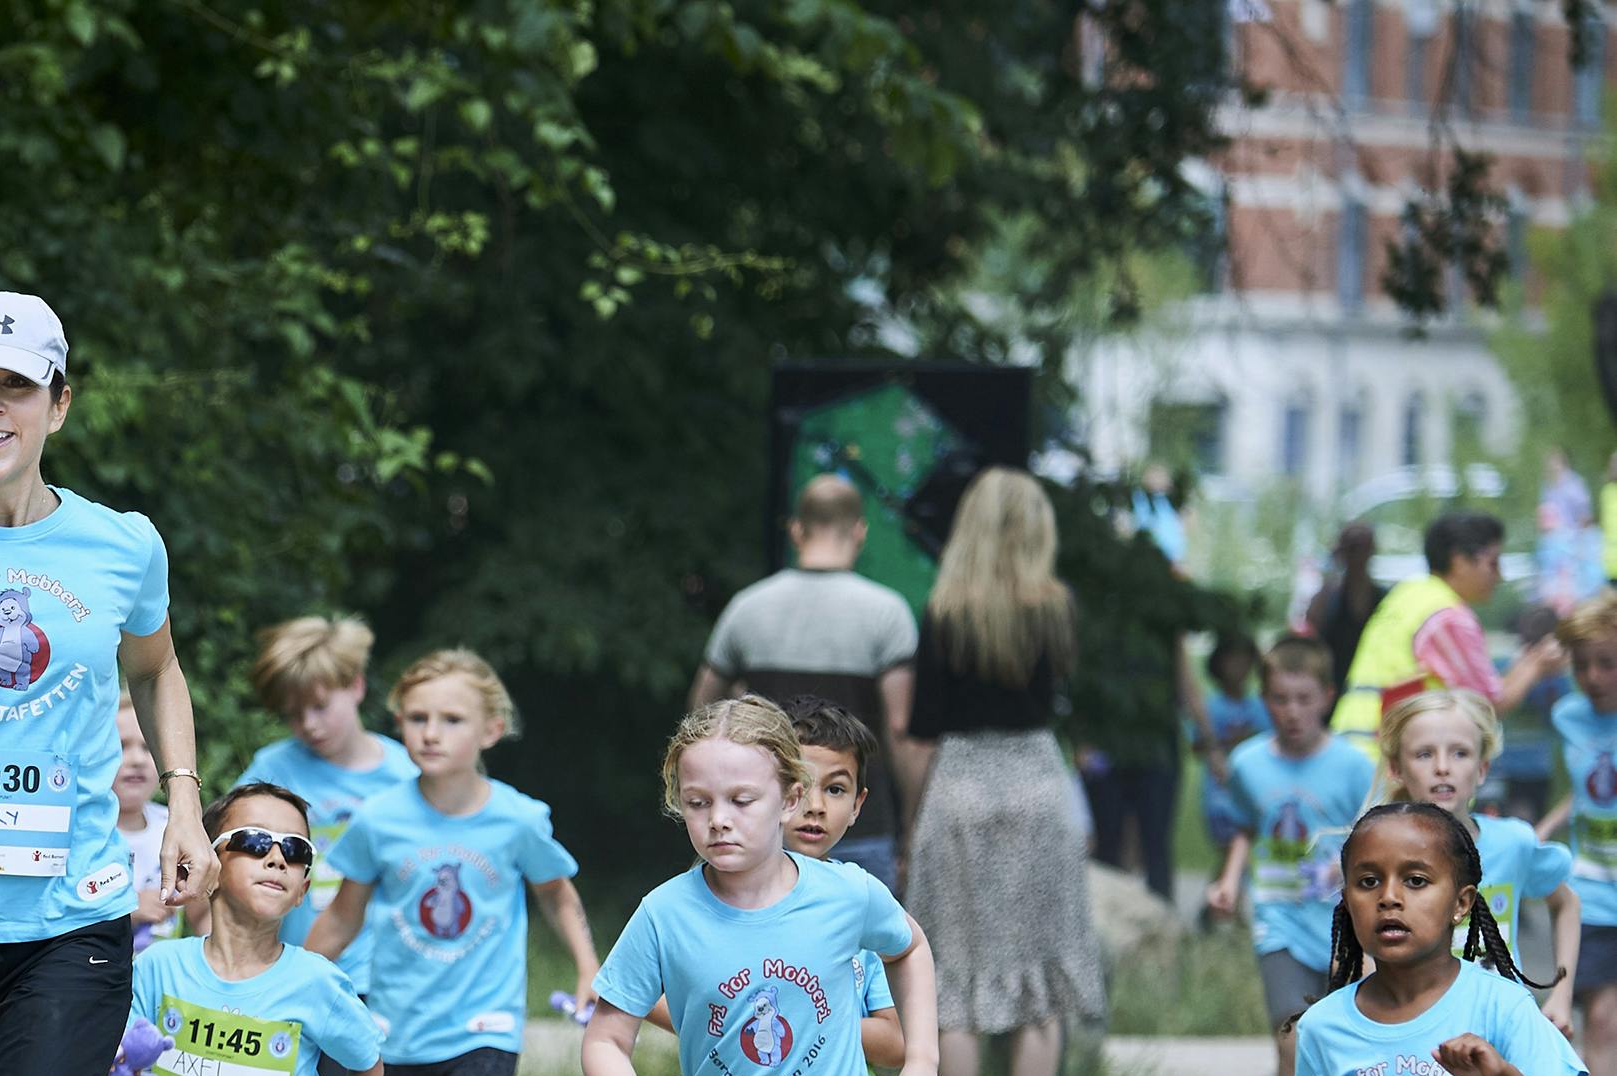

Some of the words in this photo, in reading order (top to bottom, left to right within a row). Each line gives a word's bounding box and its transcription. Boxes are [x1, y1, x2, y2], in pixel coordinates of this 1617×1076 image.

[7, 567, 91, 622] Mobberi
[707, 1002, 728, 1038] Fri
[718, 968, 751, 999] for
[763, 958, 831, 1025] Mobberi
[189, 1018, 262, 1057] 11:45
[802, 1034, 827, 1068] 2016
